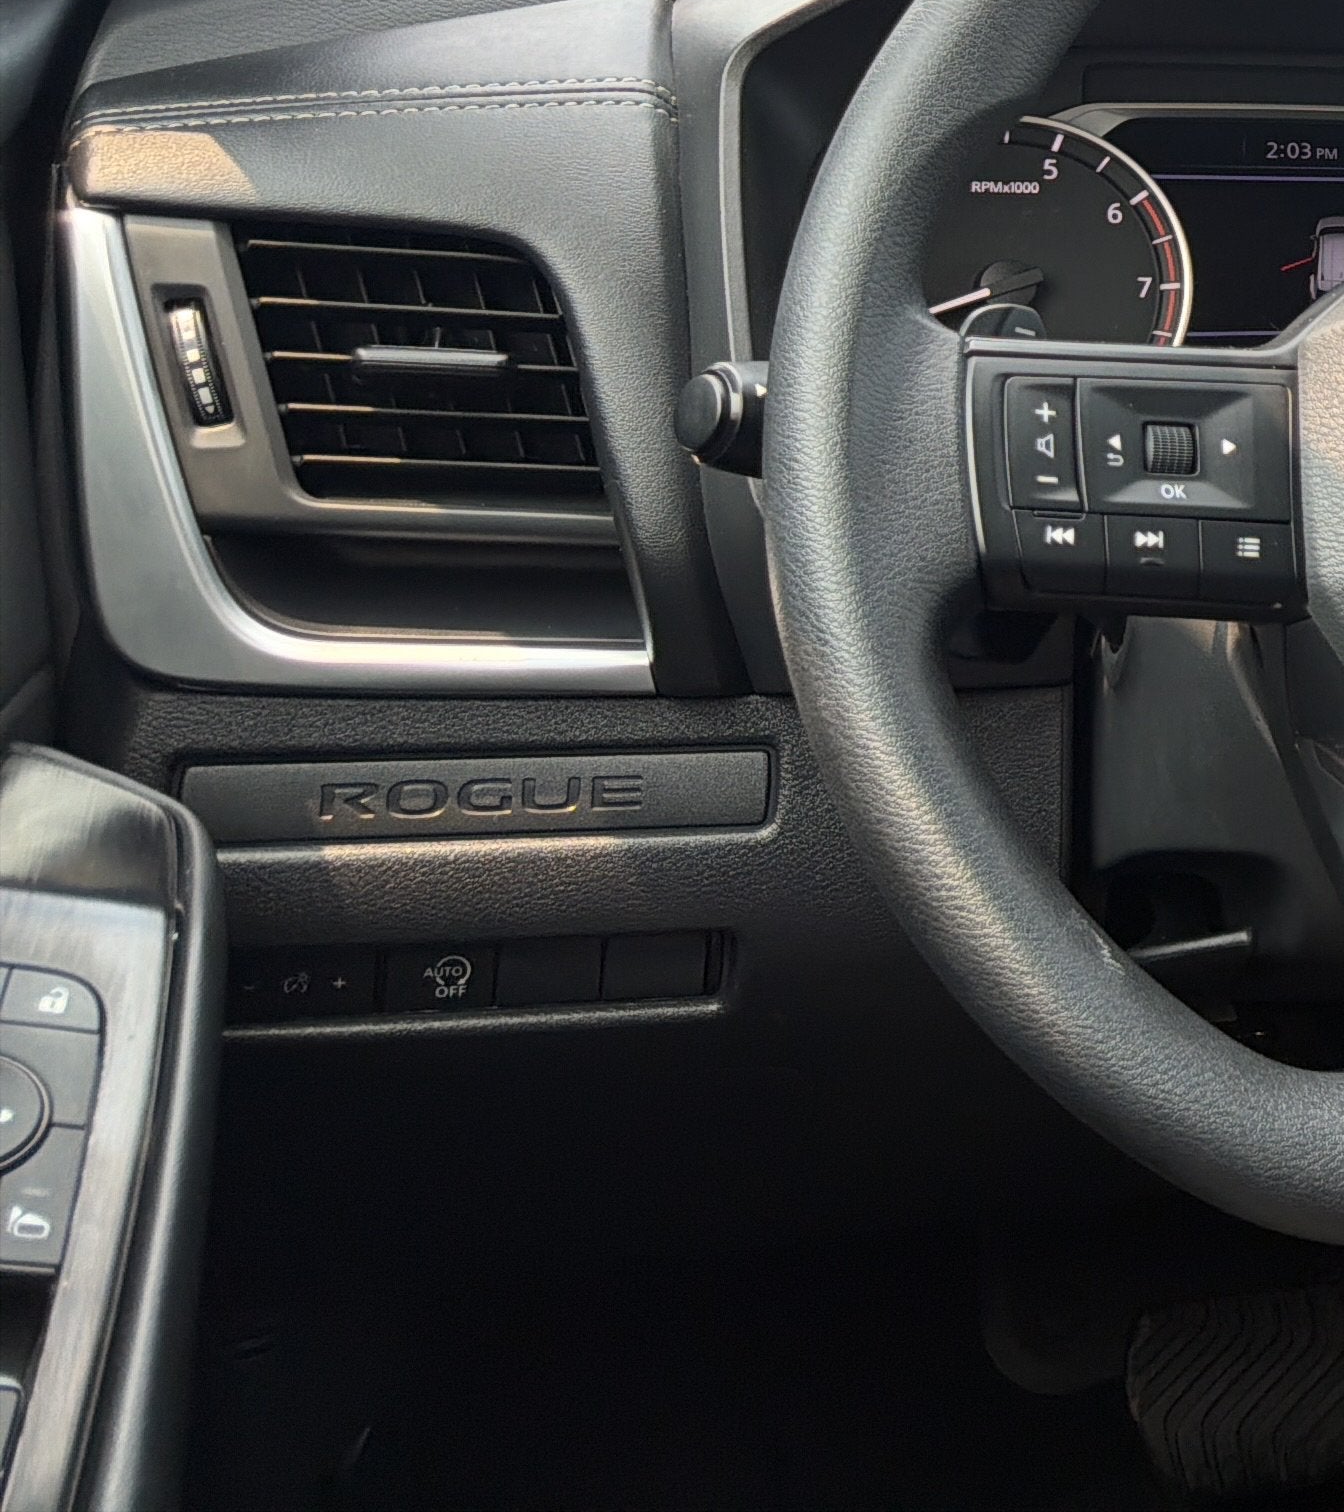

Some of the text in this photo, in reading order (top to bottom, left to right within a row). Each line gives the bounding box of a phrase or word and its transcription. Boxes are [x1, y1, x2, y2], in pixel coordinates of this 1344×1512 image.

[1265, 141, 1312, 159] 2:03
[1316, 147, 1338, 160] PM
[1043, 159, 1059, 180] 5
[970, 181, 1040, 194] RPMx1000
[1107, 203, 1123, 224] 6
[1137, 276, 1152, 298] 7
[1160, 483, 1187, 500] OK
[319, 775, 644, 821] ROGUE
[423, 965, 463, 978] AUTO
[435, 985, 467, 999] OFF
